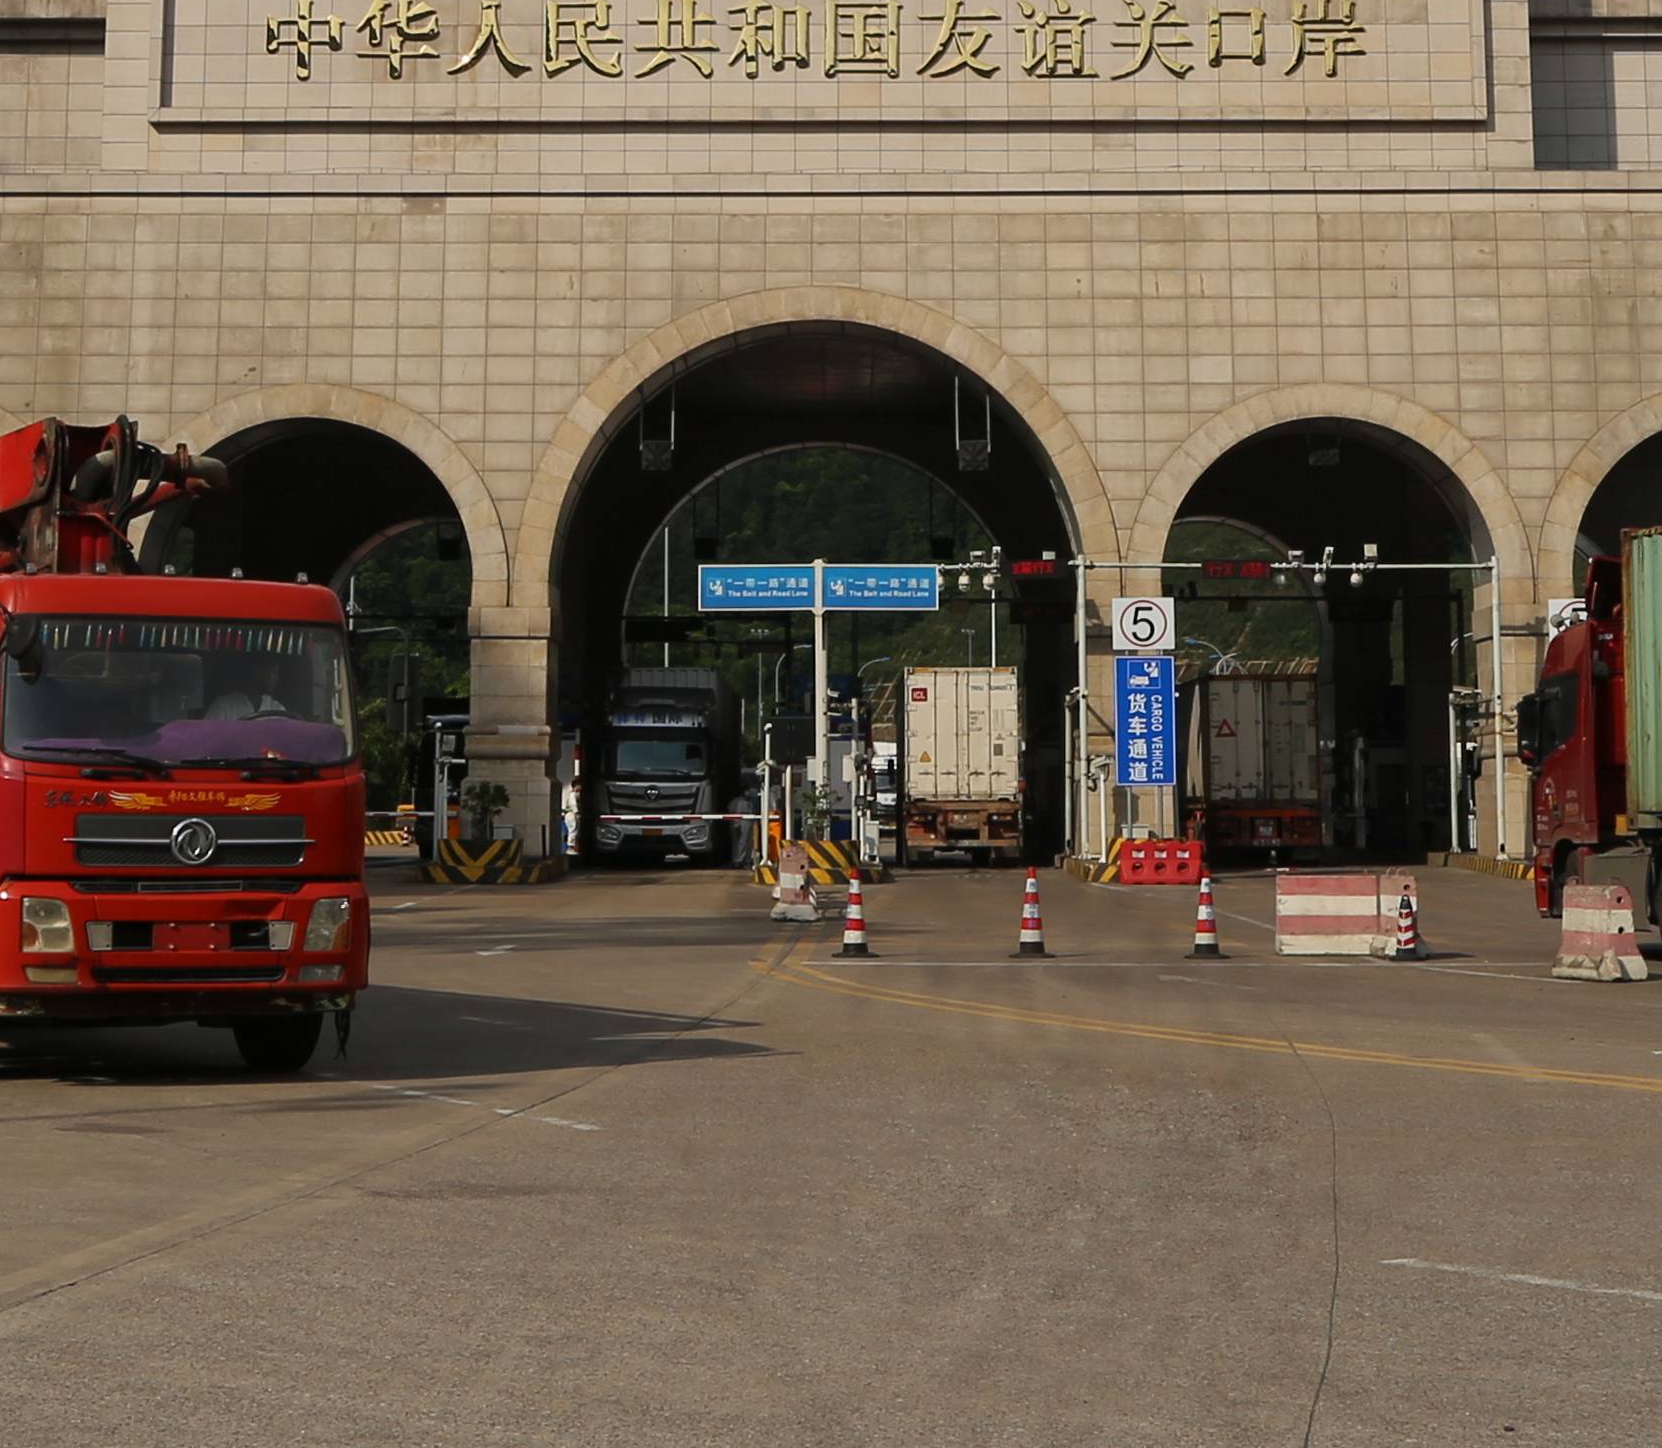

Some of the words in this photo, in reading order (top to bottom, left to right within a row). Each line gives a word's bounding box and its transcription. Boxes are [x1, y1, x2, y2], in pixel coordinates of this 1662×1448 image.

[727, 590, 742, 598] The
[743, 590, 757, 598] Belt
[758, 590, 772, 598] and
[772, 590, 790, 598] Road
[791, 590, 809, 598] Lane
[849, 590, 863, 598] The
[864, 590, 878, 598] Belt
[879, 590, 893, 598] and
[893, 590, 911, 598] Road
[912, 590, 930, 598] Lane
[1131, 606, 1156, 643] 5
[1150, 694, 1163, 732] CARGO
[1127, 692, 1149, 783] 货车通道
[1151, 735, 1164, 781] VEHICLE
